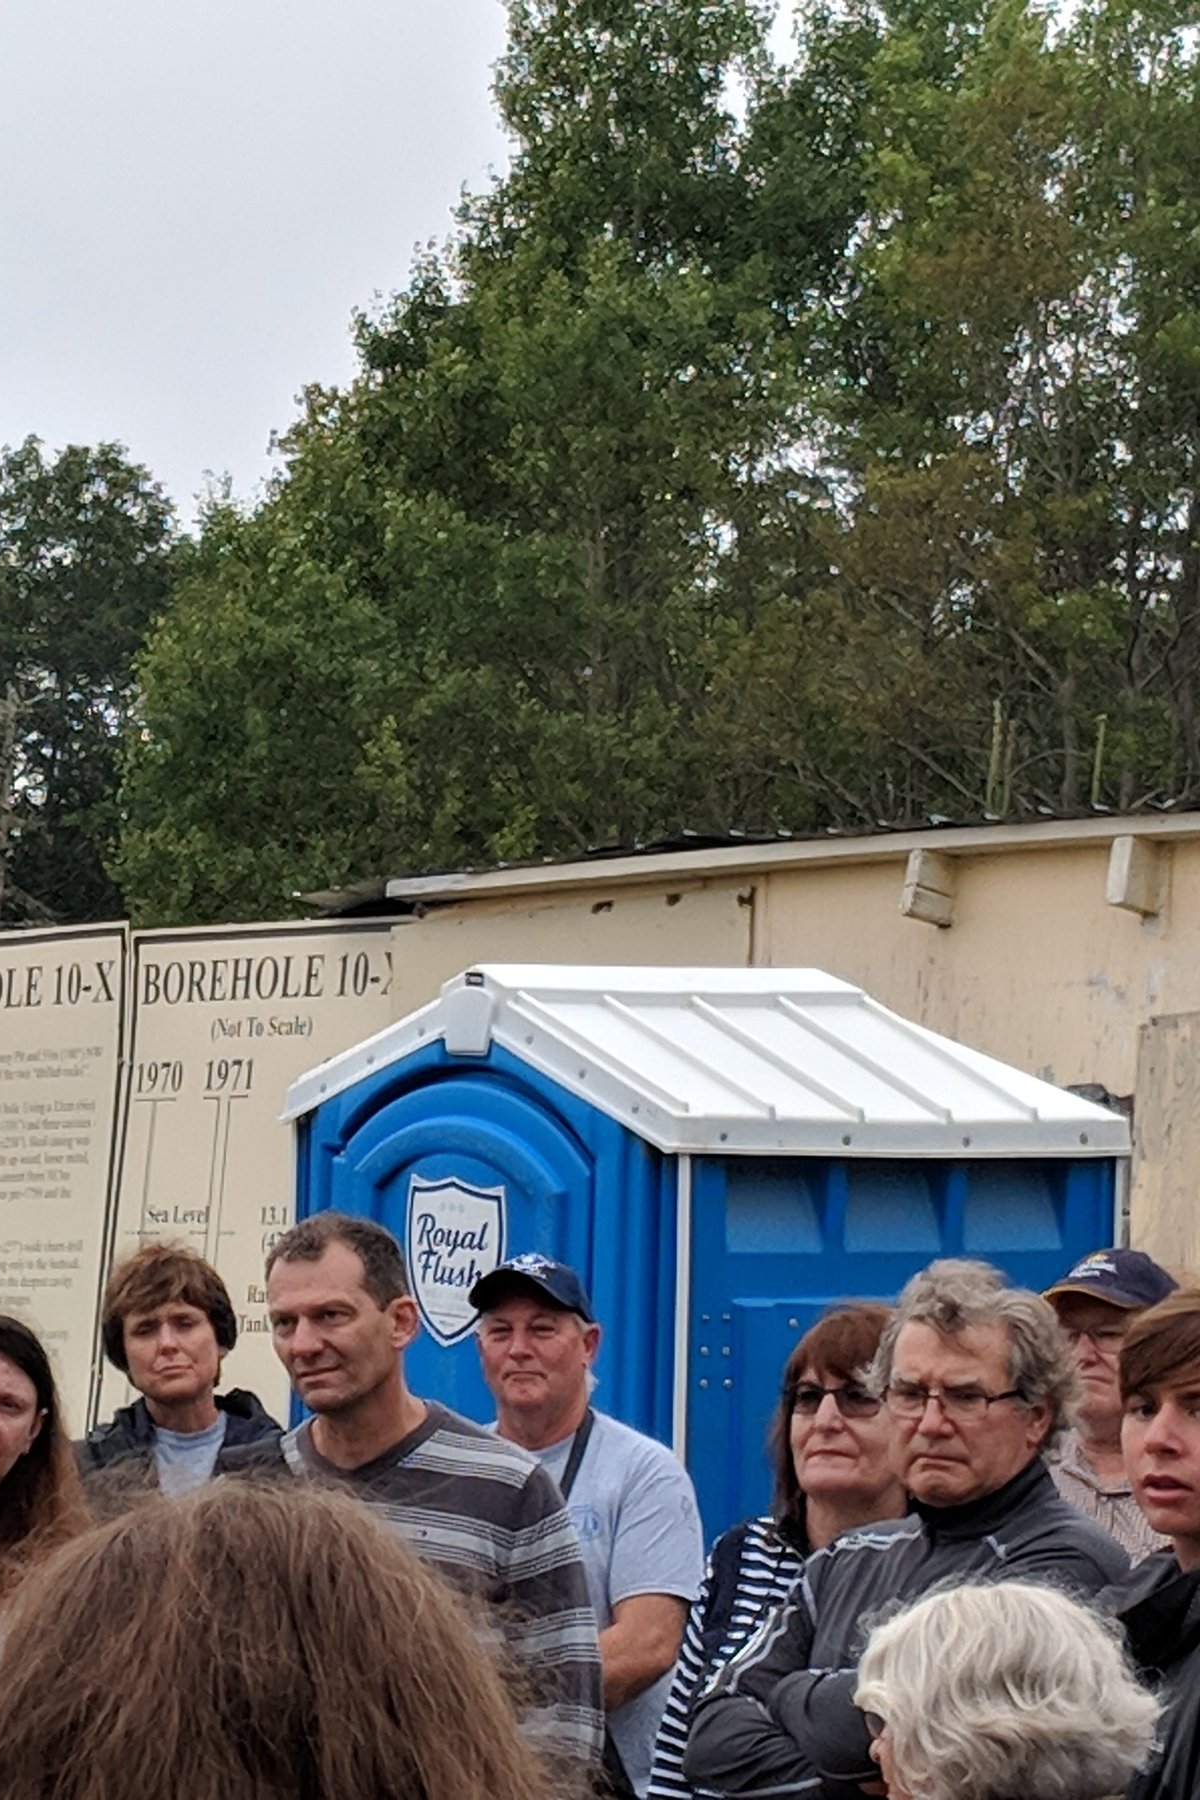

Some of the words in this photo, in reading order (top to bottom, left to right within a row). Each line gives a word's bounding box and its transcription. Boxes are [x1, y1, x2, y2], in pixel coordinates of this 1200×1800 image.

[53, 960, 116, 1005] 10-X
[142, 954, 325, 1005] BOREHOLE
[211, 1017, 241, 1042] (Not
[247, 1016, 265, 1037] To
[268, 1015, 313, 1038] Scale)
[136, 1061, 183, 1094] 1970
[203, 1058, 255, 1092] 1971
[147, 1205, 168, 1224] Sea
[173, 1205, 210, 1224] Level
[417, 1213, 489, 1258] Royal
[418, 1250, 483, 1288] Flush
